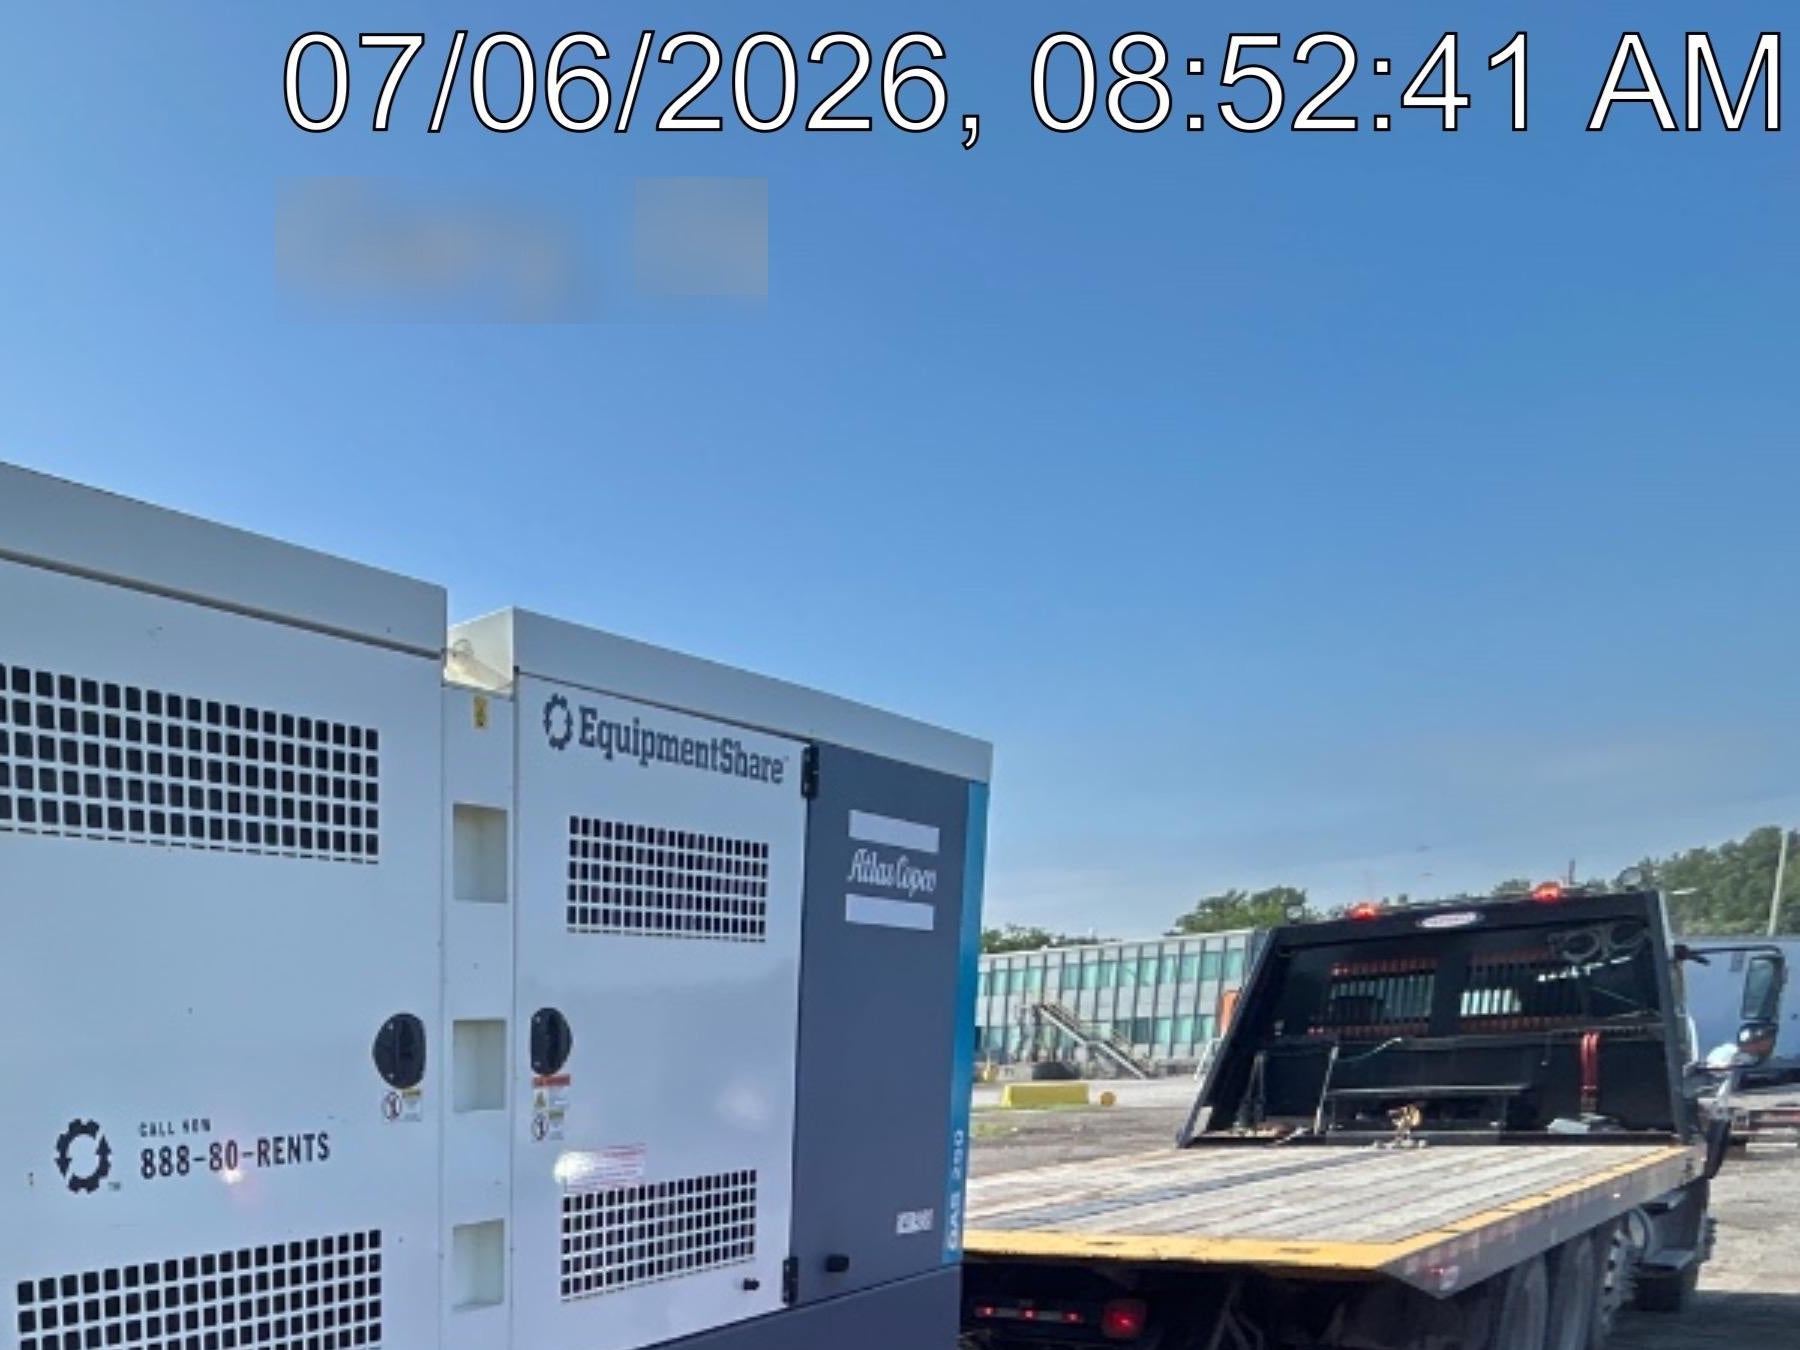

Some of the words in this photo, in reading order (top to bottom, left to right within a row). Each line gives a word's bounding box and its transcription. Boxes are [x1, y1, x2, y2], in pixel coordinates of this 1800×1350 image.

[579, 704, 784, 785] EquipmentShare
[847, 847, 895, 887] Atlas
[139, 1121, 175, 1137] CALL
[140, 1132, 331, 1180] 888-80-RENTS
